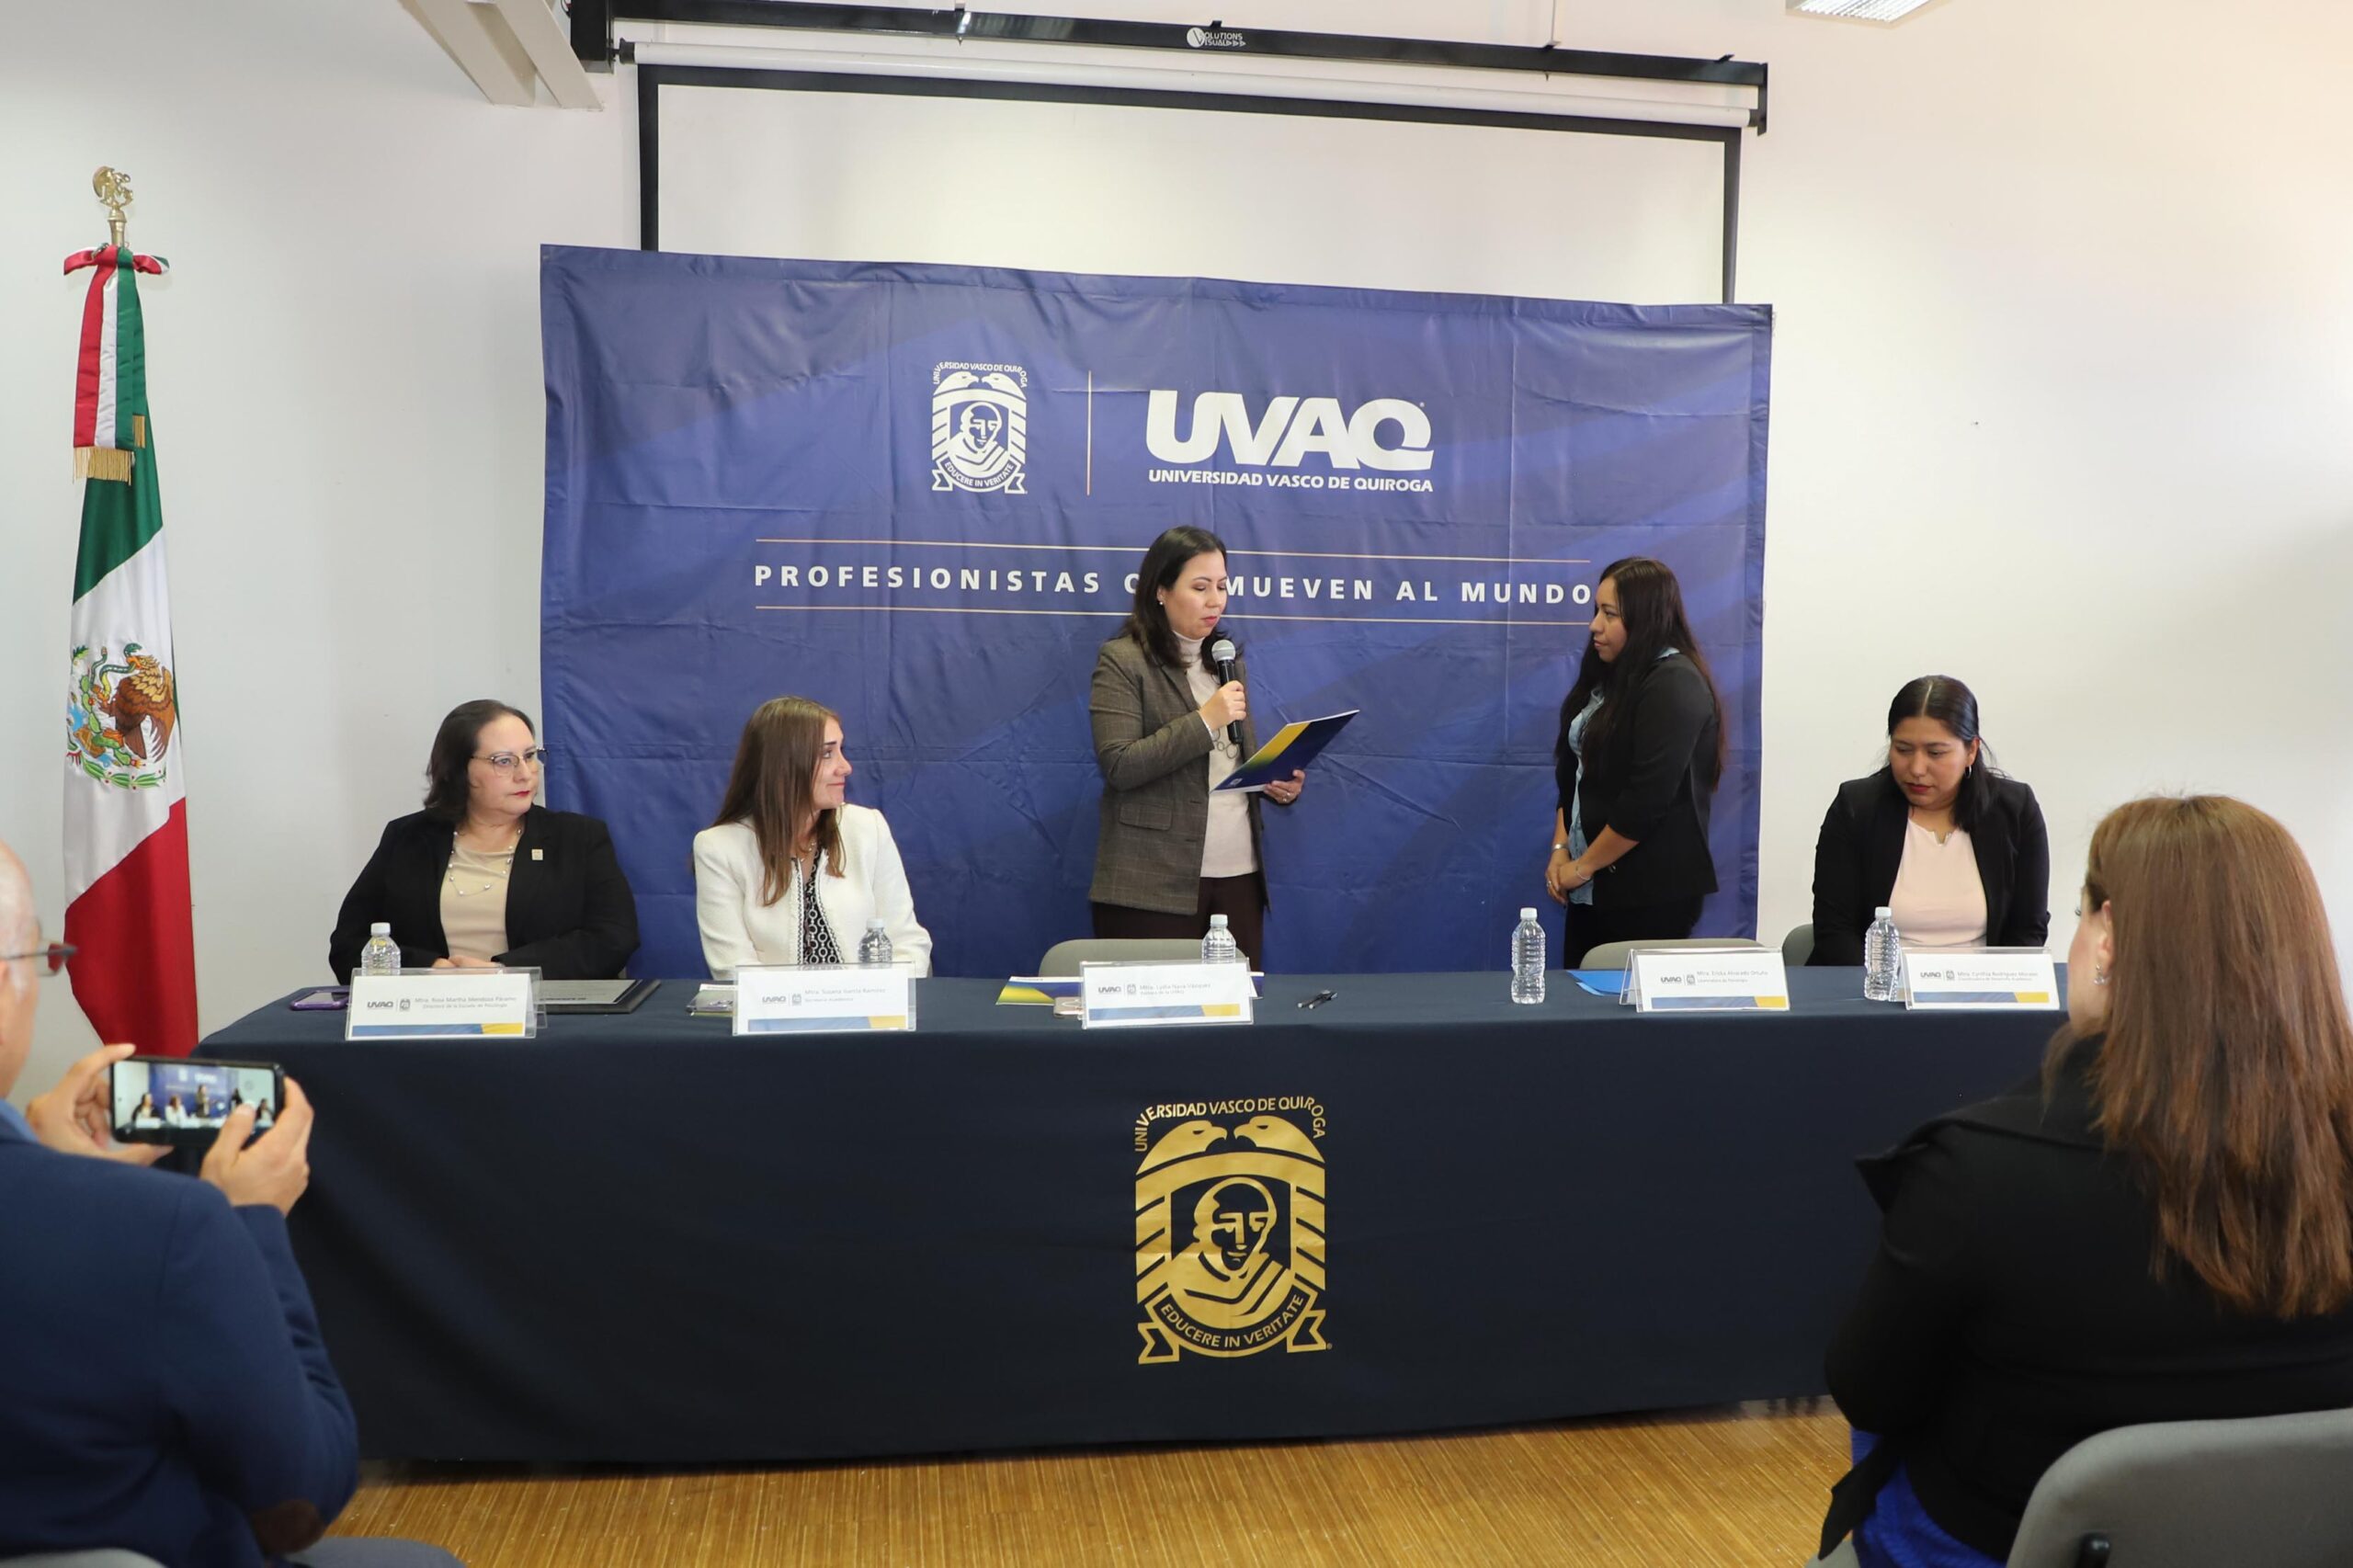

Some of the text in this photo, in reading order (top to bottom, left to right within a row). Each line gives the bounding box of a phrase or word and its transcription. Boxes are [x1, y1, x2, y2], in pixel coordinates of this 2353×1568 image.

[933, 361, 1028, 388] UNIVERSIDAD VASCO DE QUIROGA
[1146, 390, 1434, 471] UVAQ
[944, 461, 1015, 486] EDUCERE IN VERITATE
[1148, 469, 1434, 493] UNIVERSIDAD VASCO DE QUIROGA
[755, 564, 1099, 594] PROFESIONISTAS
[1224, 575, 1591, 605] MUEVEN AL MUNDO
[1135, 1096, 1326, 1152] UNIVERSIDAD VASCO DE QUIROGA
[1160, 1293, 1304, 1348] EDUCERE IN VERITATE
